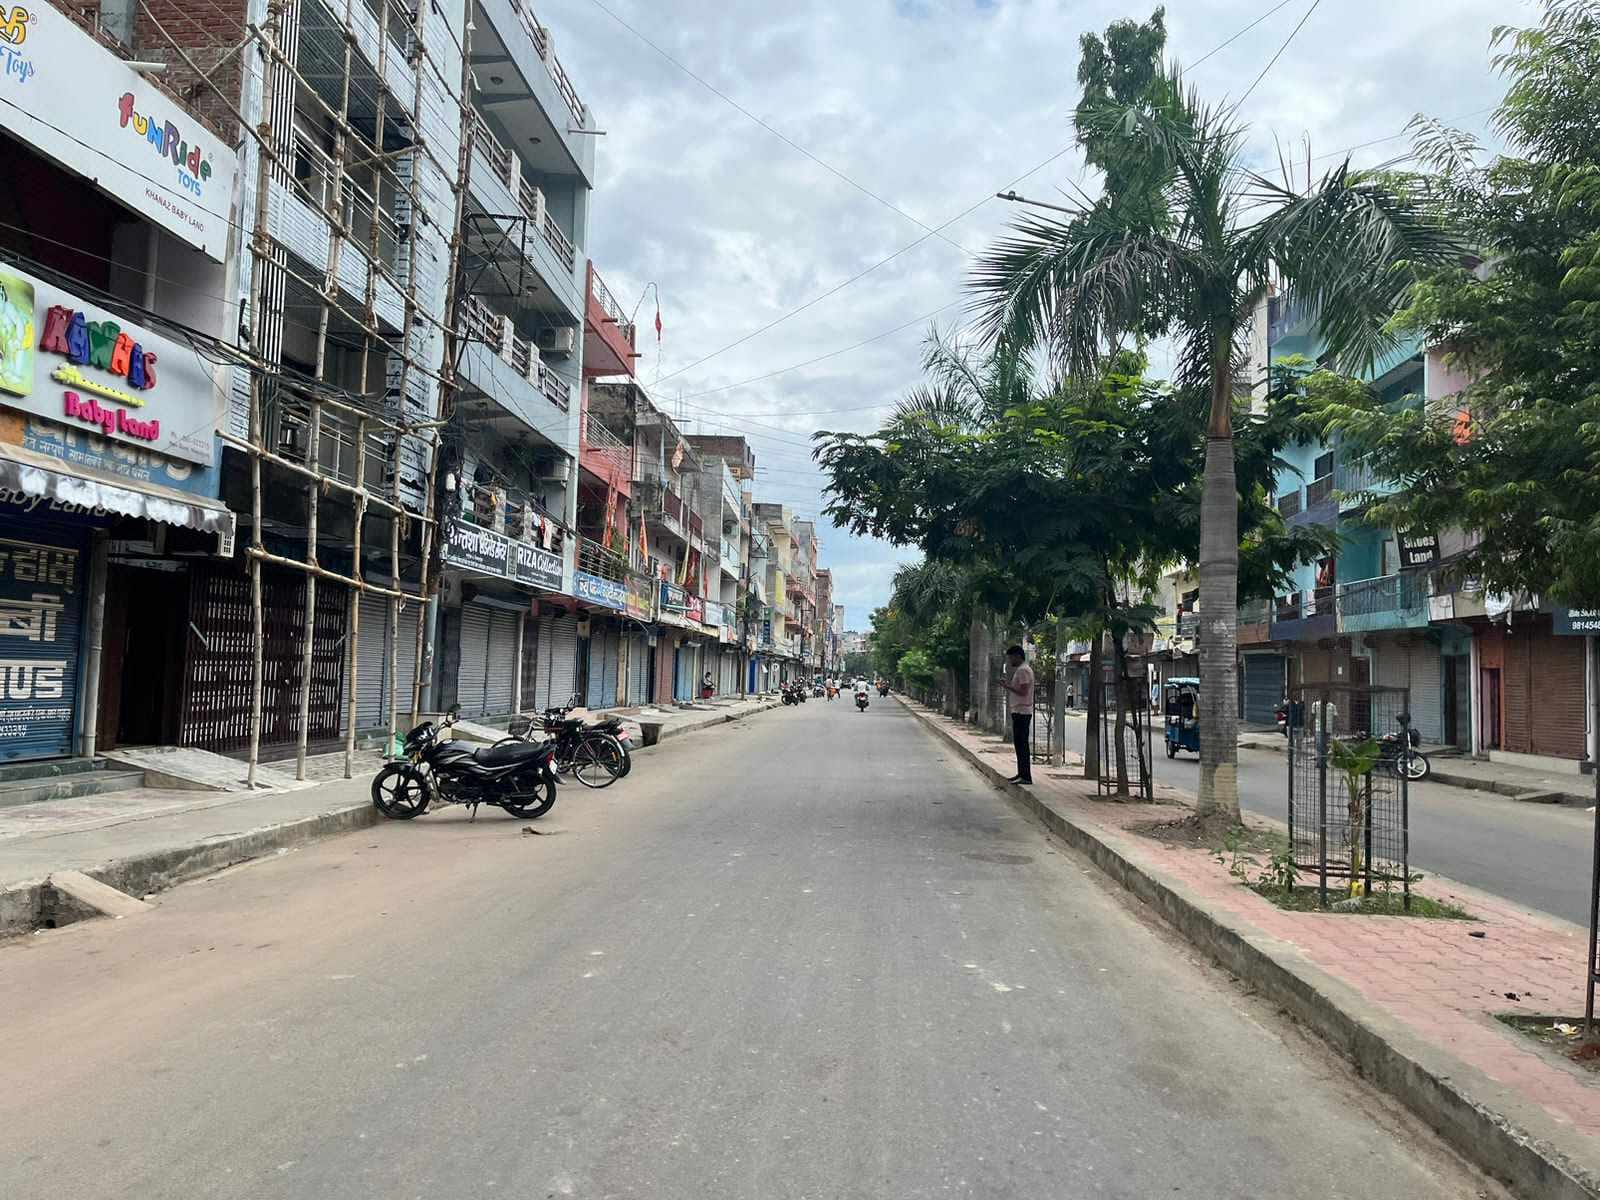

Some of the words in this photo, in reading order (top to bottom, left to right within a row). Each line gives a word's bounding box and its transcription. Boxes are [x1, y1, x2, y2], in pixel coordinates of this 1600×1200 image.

[177, 168, 201, 197] TOYS
[172, 205, 189, 221] BABY
[189, 216, 204, 233] LAND
[64, 391, 114, 435] Baby
[117, 409, 160, 441] Land
[517, 546, 537, 570] RIZA
